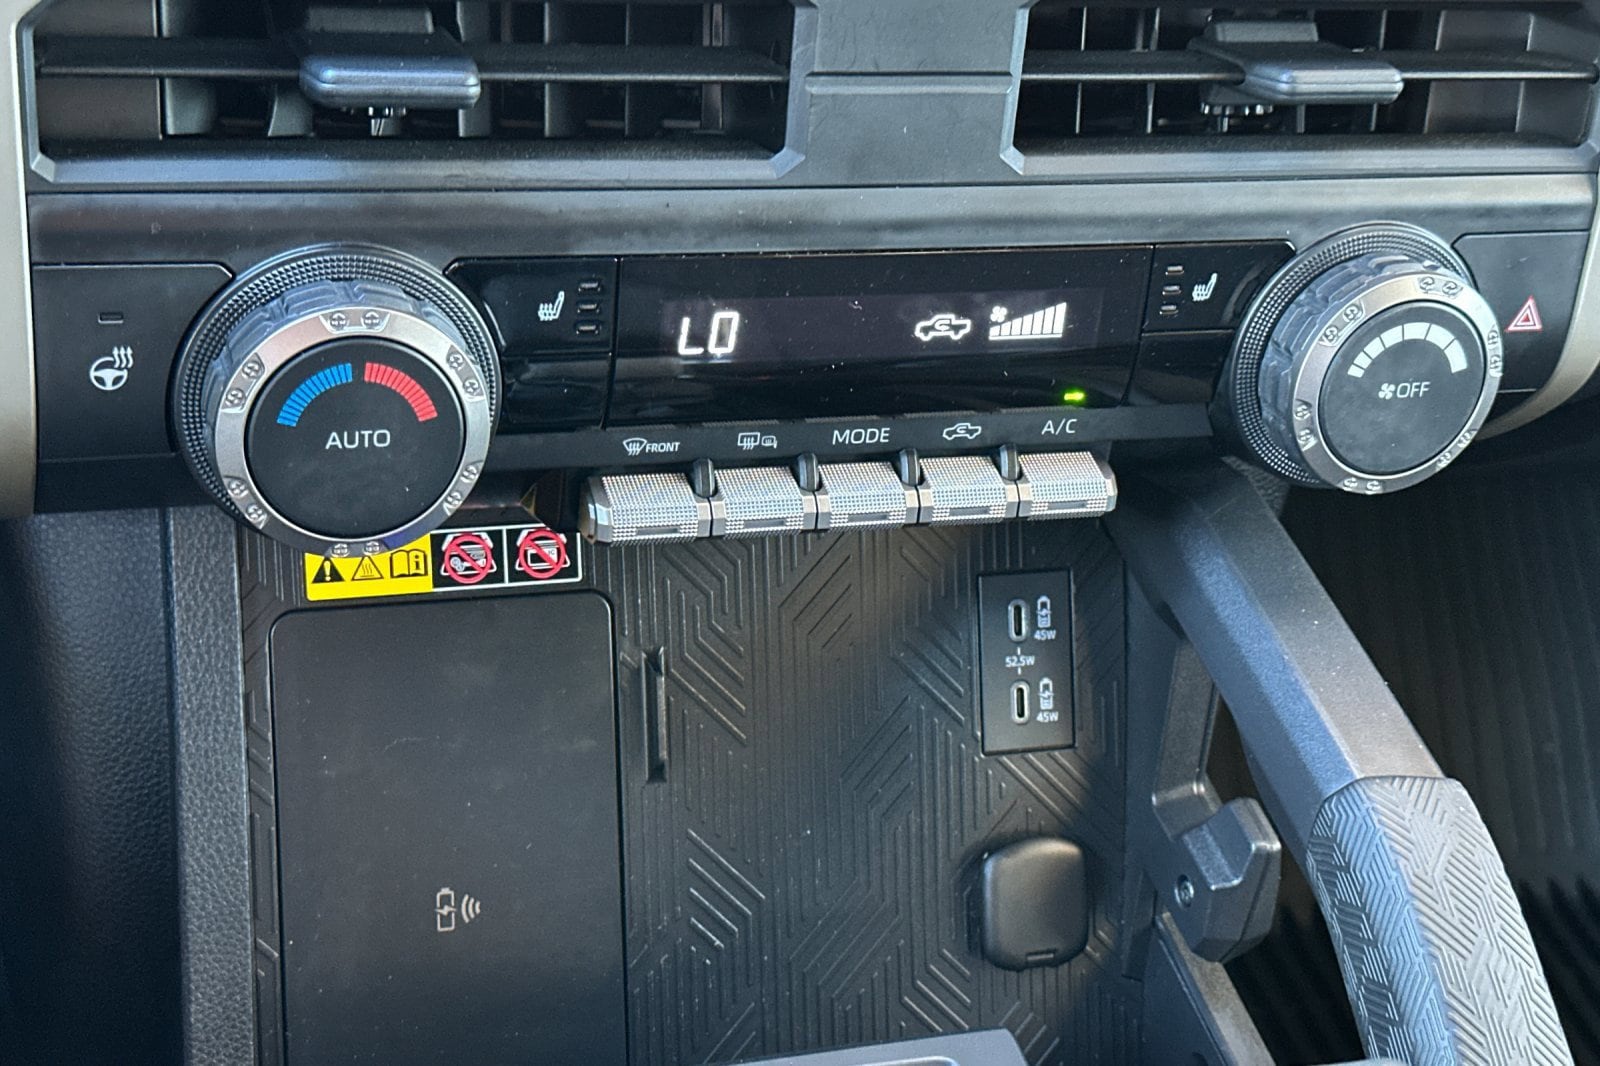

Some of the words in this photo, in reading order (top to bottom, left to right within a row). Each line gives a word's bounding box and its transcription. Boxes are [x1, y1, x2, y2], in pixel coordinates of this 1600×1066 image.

[677, 310, 740, 357] LO
[1396, 381, 1431, 399] OFF
[832, 427, 890, 445] MODE
[1041, 418, 1078, 436] A/C
[325, 429, 391, 450] AUTO
[645, 441, 680, 453] FRONT
[1034, 629, 1057, 641] 45W
[1005, 655, 1036, 668] 52.5W
[1036, 711, 1060, 723] 45W
